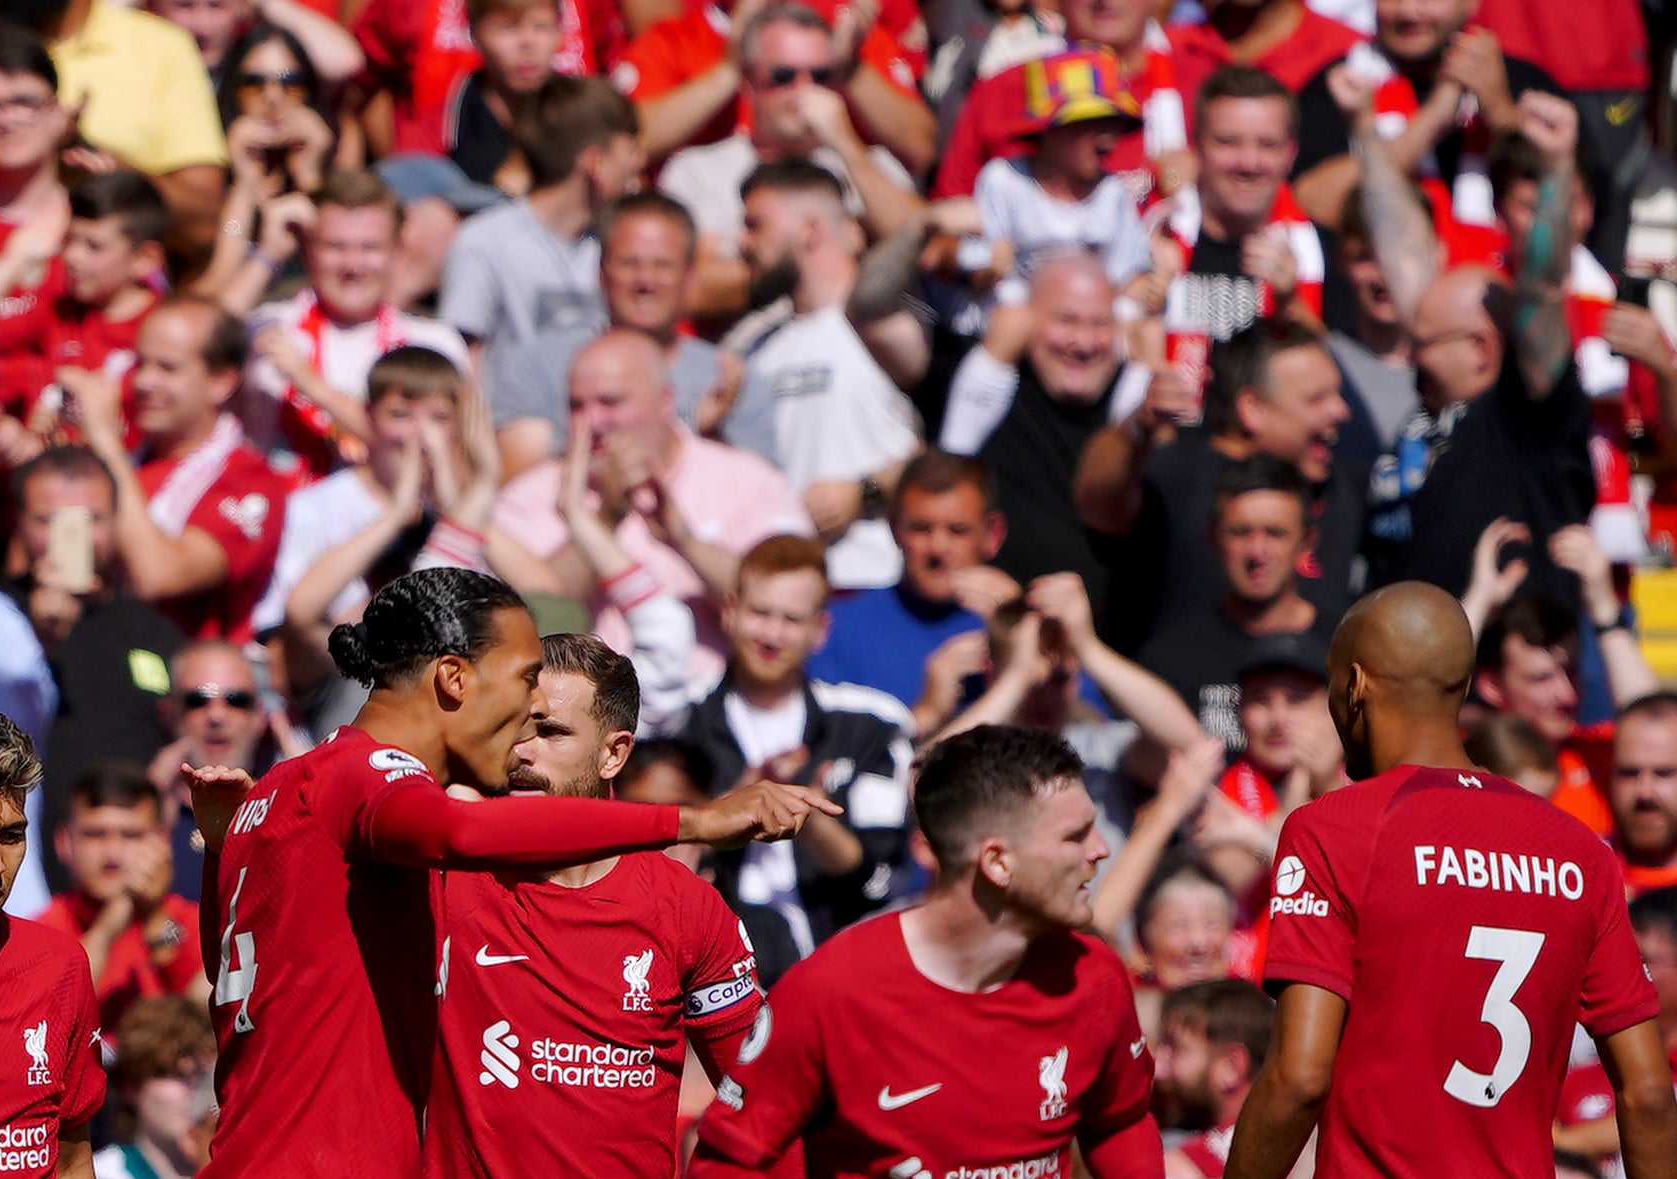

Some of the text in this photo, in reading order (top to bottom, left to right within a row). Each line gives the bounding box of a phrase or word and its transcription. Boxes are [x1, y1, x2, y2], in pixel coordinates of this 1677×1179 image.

[1414, 846, 1584, 900] FABINHO
[215, 866, 259, 1034] 4
[1443, 925, 1546, 1107] 3
[530, 1060, 656, 1088] chartered
[531, 1037, 655, 1067] standard
